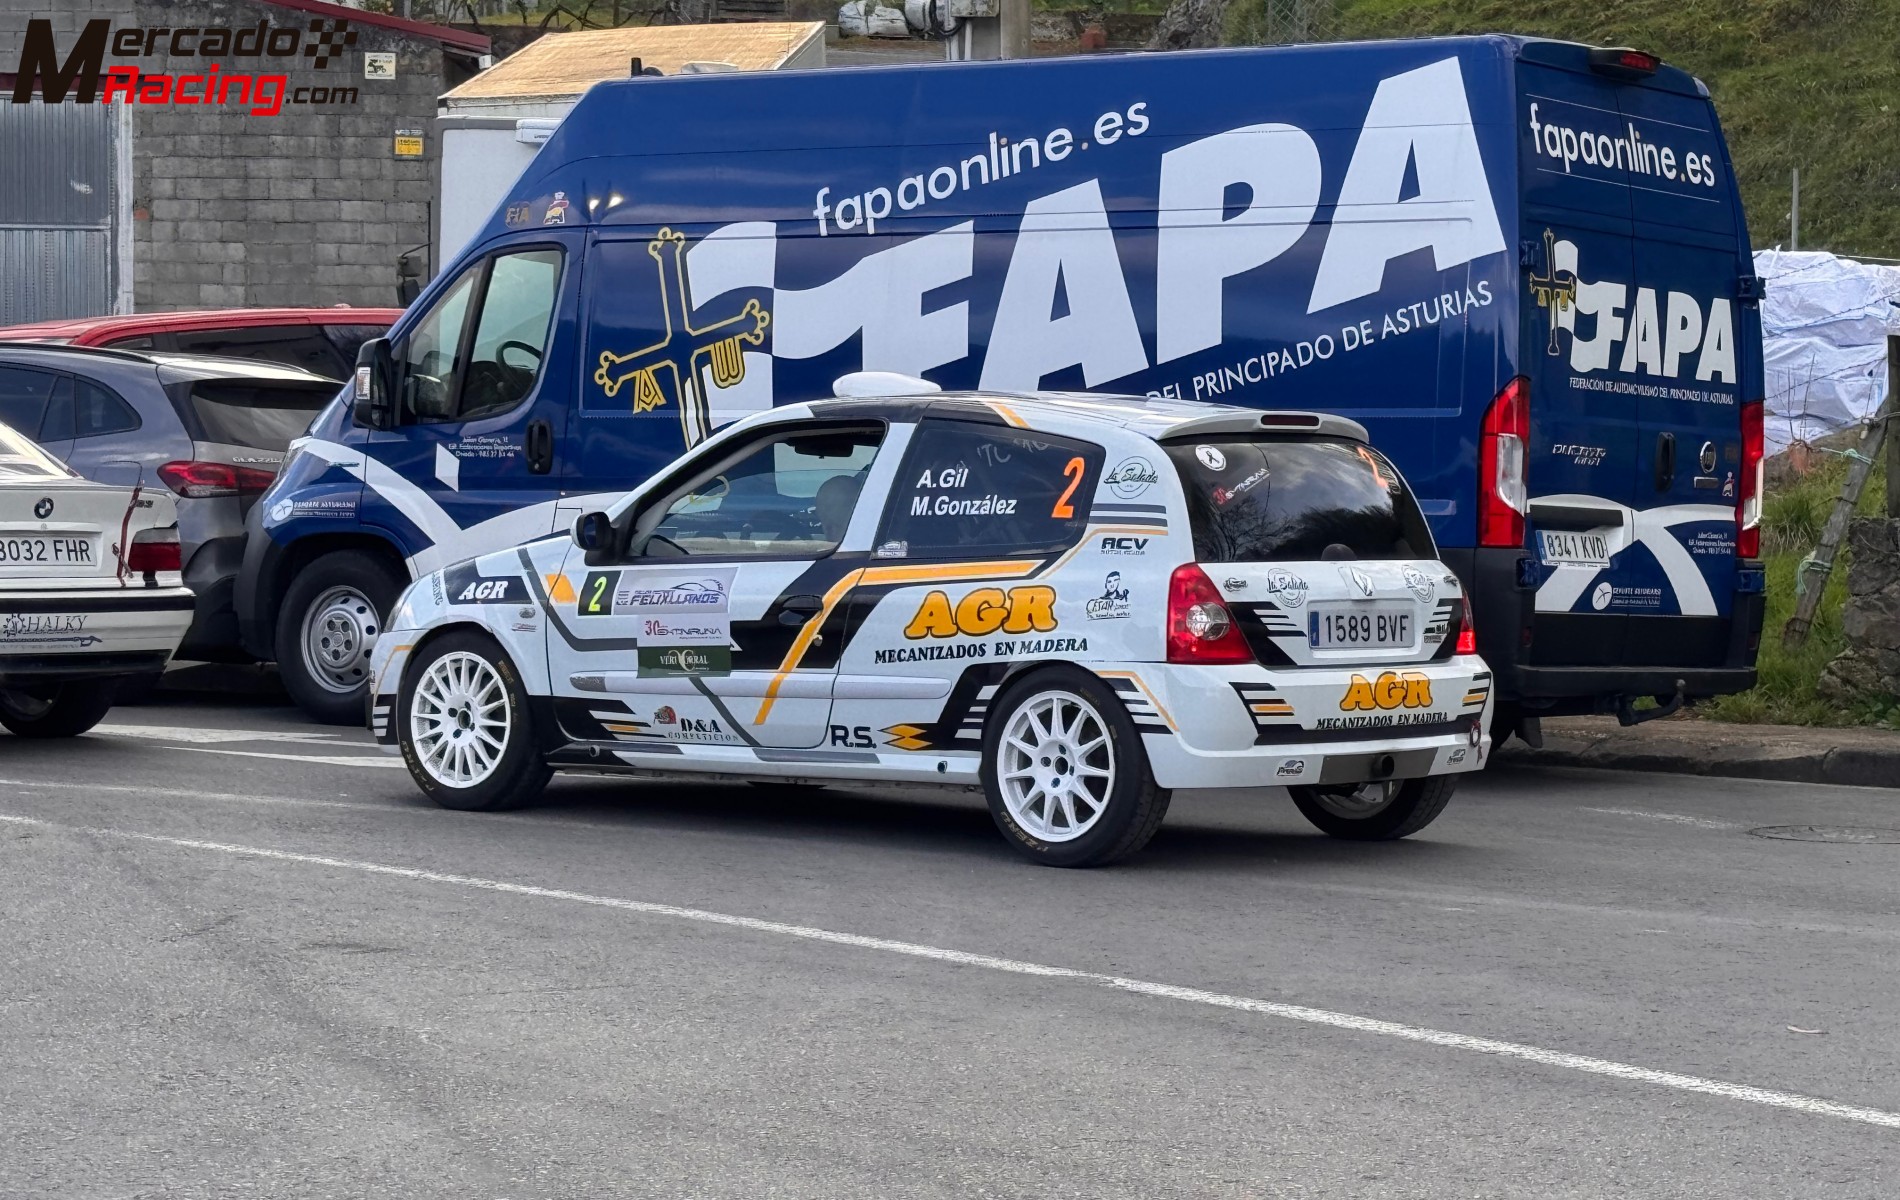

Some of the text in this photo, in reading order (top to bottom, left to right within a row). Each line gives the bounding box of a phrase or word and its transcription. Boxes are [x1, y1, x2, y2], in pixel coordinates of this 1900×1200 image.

[1529, 102, 1715, 187] fapaonline.es
[813, 102, 1150, 237] fapaonline.es
[772, 57, 1506, 393] FAPA
[1193, 334, 1335, 399] PRINCIPADO
[1342, 320, 1374, 352] DE
[1382, 280, 1493, 340] ASTURIAS
[1569, 281, 1737, 384] FAPA
[916, 467, 969, 489] A.Gil
[1051, 456, 1085, 519] 2
[910, 494, 1018, 517] M.González
[53, 539, 92, 562] FHR
[1546, 534, 1605, 559] 8341 KVD
[458, 581, 508, 600] AGR
[588, 576, 607, 612] 2
[904, 585, 1058, 640] AGR
[1325, 615, 1409, 643] 1589 BVF
[875, 637, 1089, 664] MECANIZADOS EN MADERA
[1340, 671, 1433, 711] AGR
[1316, 712, 1448, 730] MECANIZADOS EN MADERA
